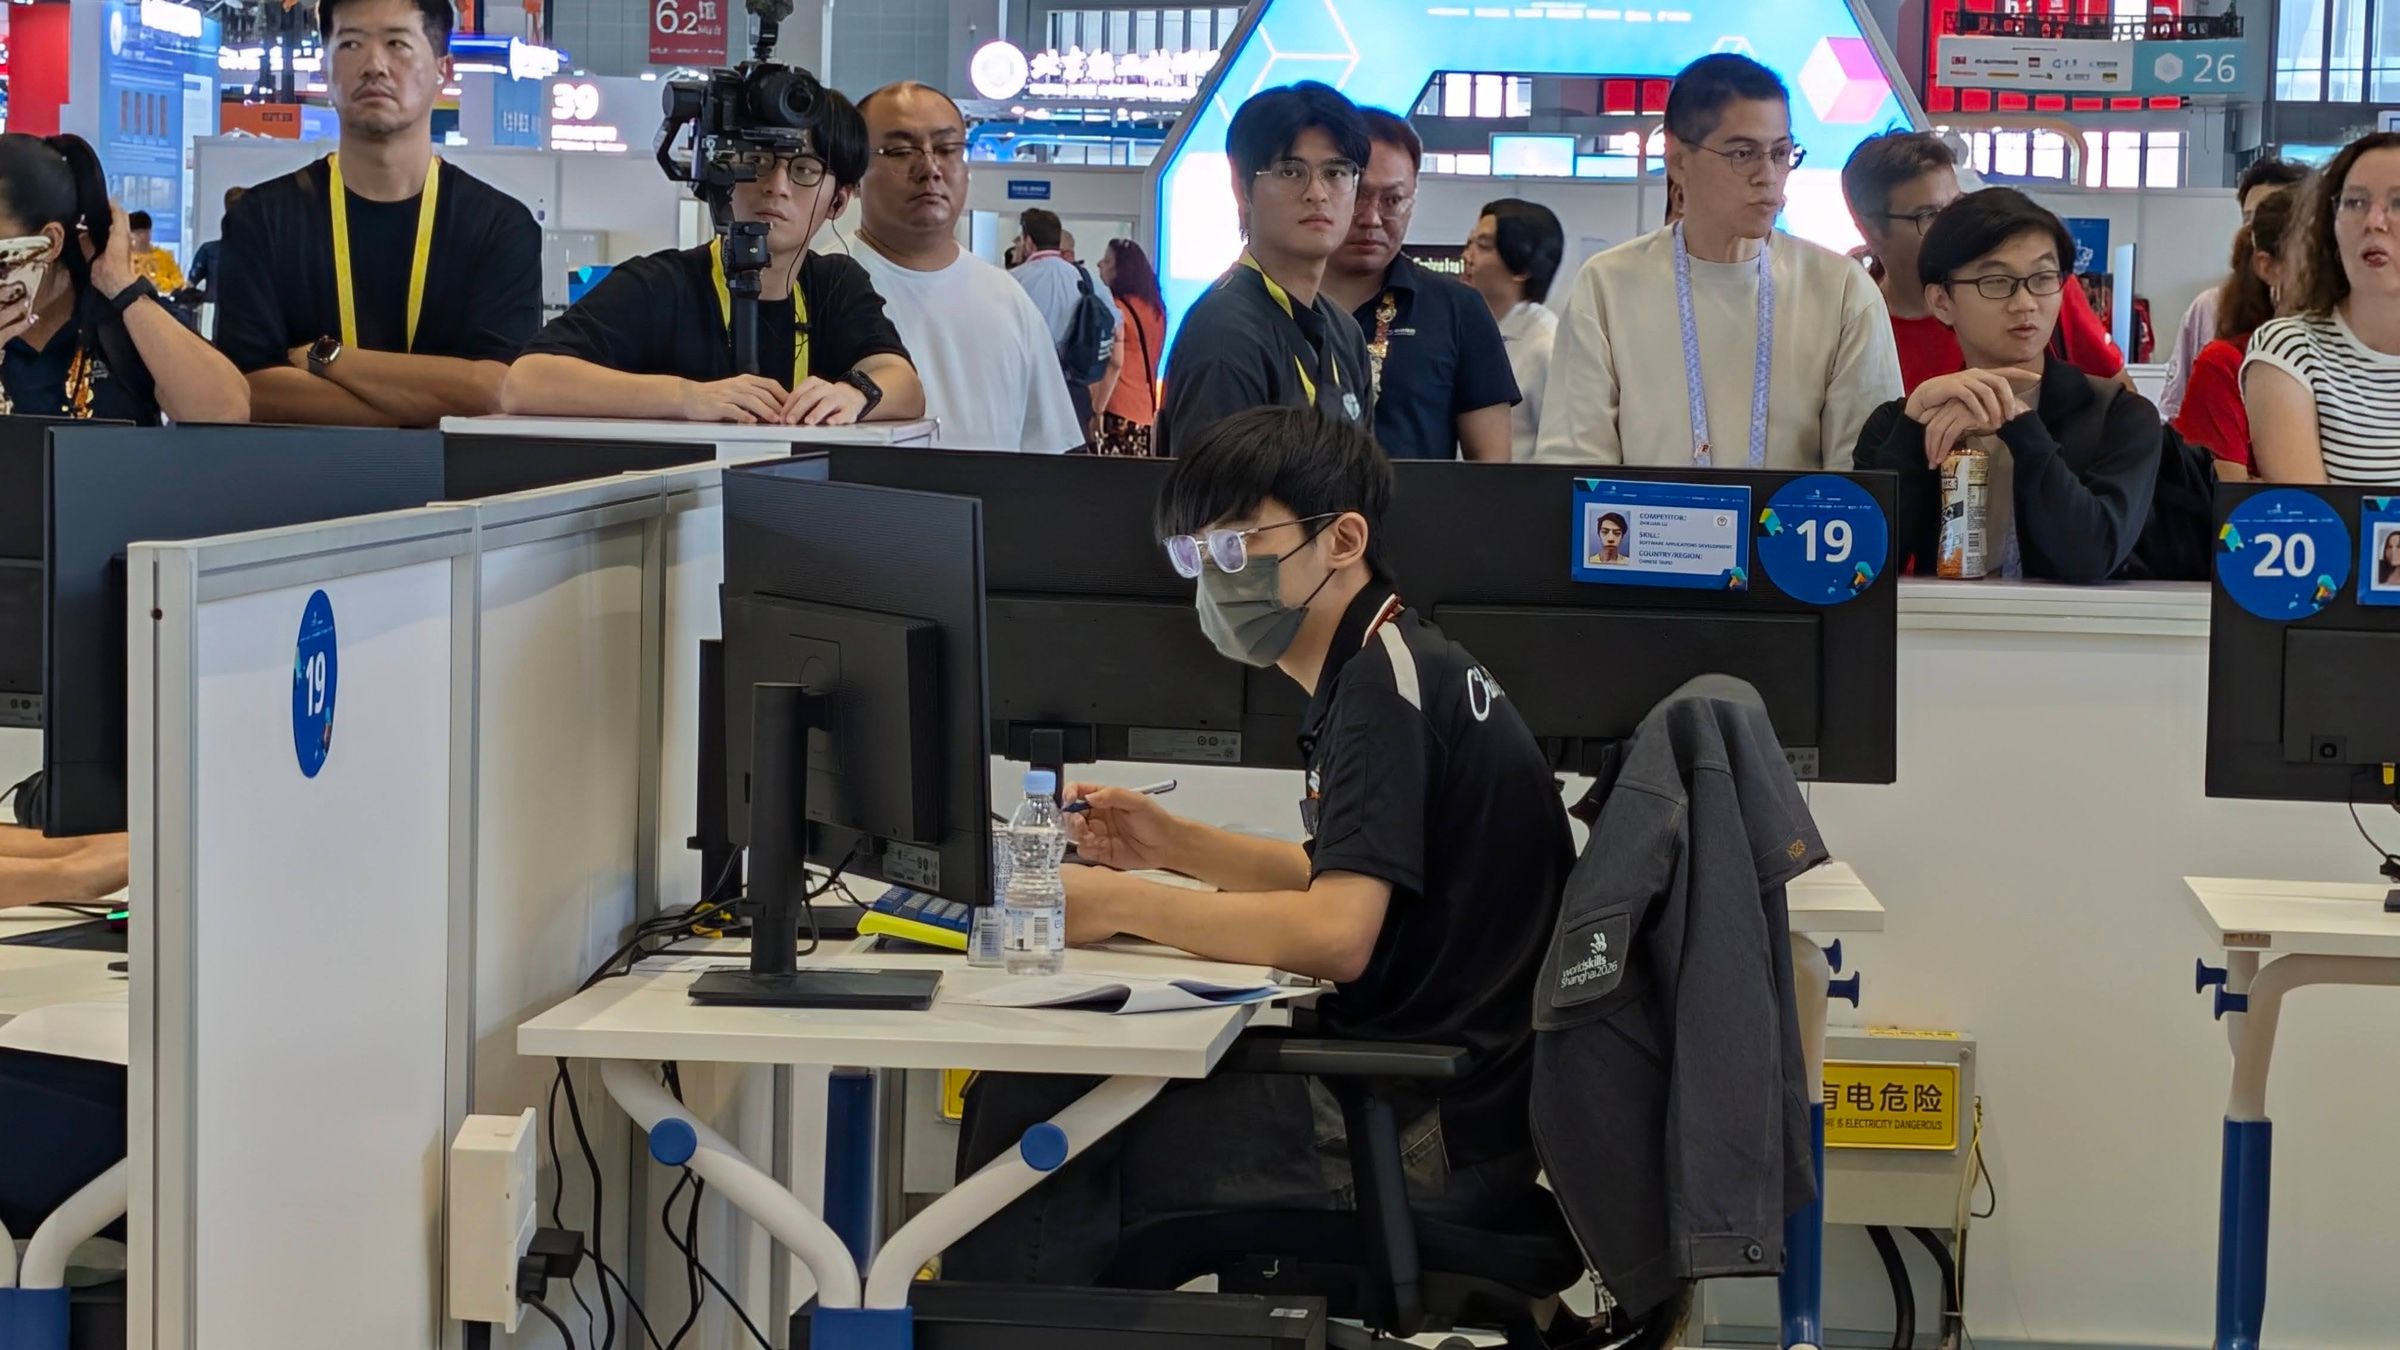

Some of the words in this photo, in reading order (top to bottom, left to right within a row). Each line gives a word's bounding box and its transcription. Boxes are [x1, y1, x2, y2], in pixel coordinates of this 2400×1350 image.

[656, 0, 698, 34] 6.2
[2193, 54, 2236, 83] 26
[1639, 512, 1687, 521] COMPETITOR:
[1638, 550, 1703, 560] COUNTRY/REGION:
[1795, 519, 1853, 563] 19
[2253, 533, 2316, 578] 20
[306, 651, 326, 717] 19
[1845, 1118, 1894, 1129] ELECTRICITY
[1894, 1119, 1943, 1130] DANGEROUS
